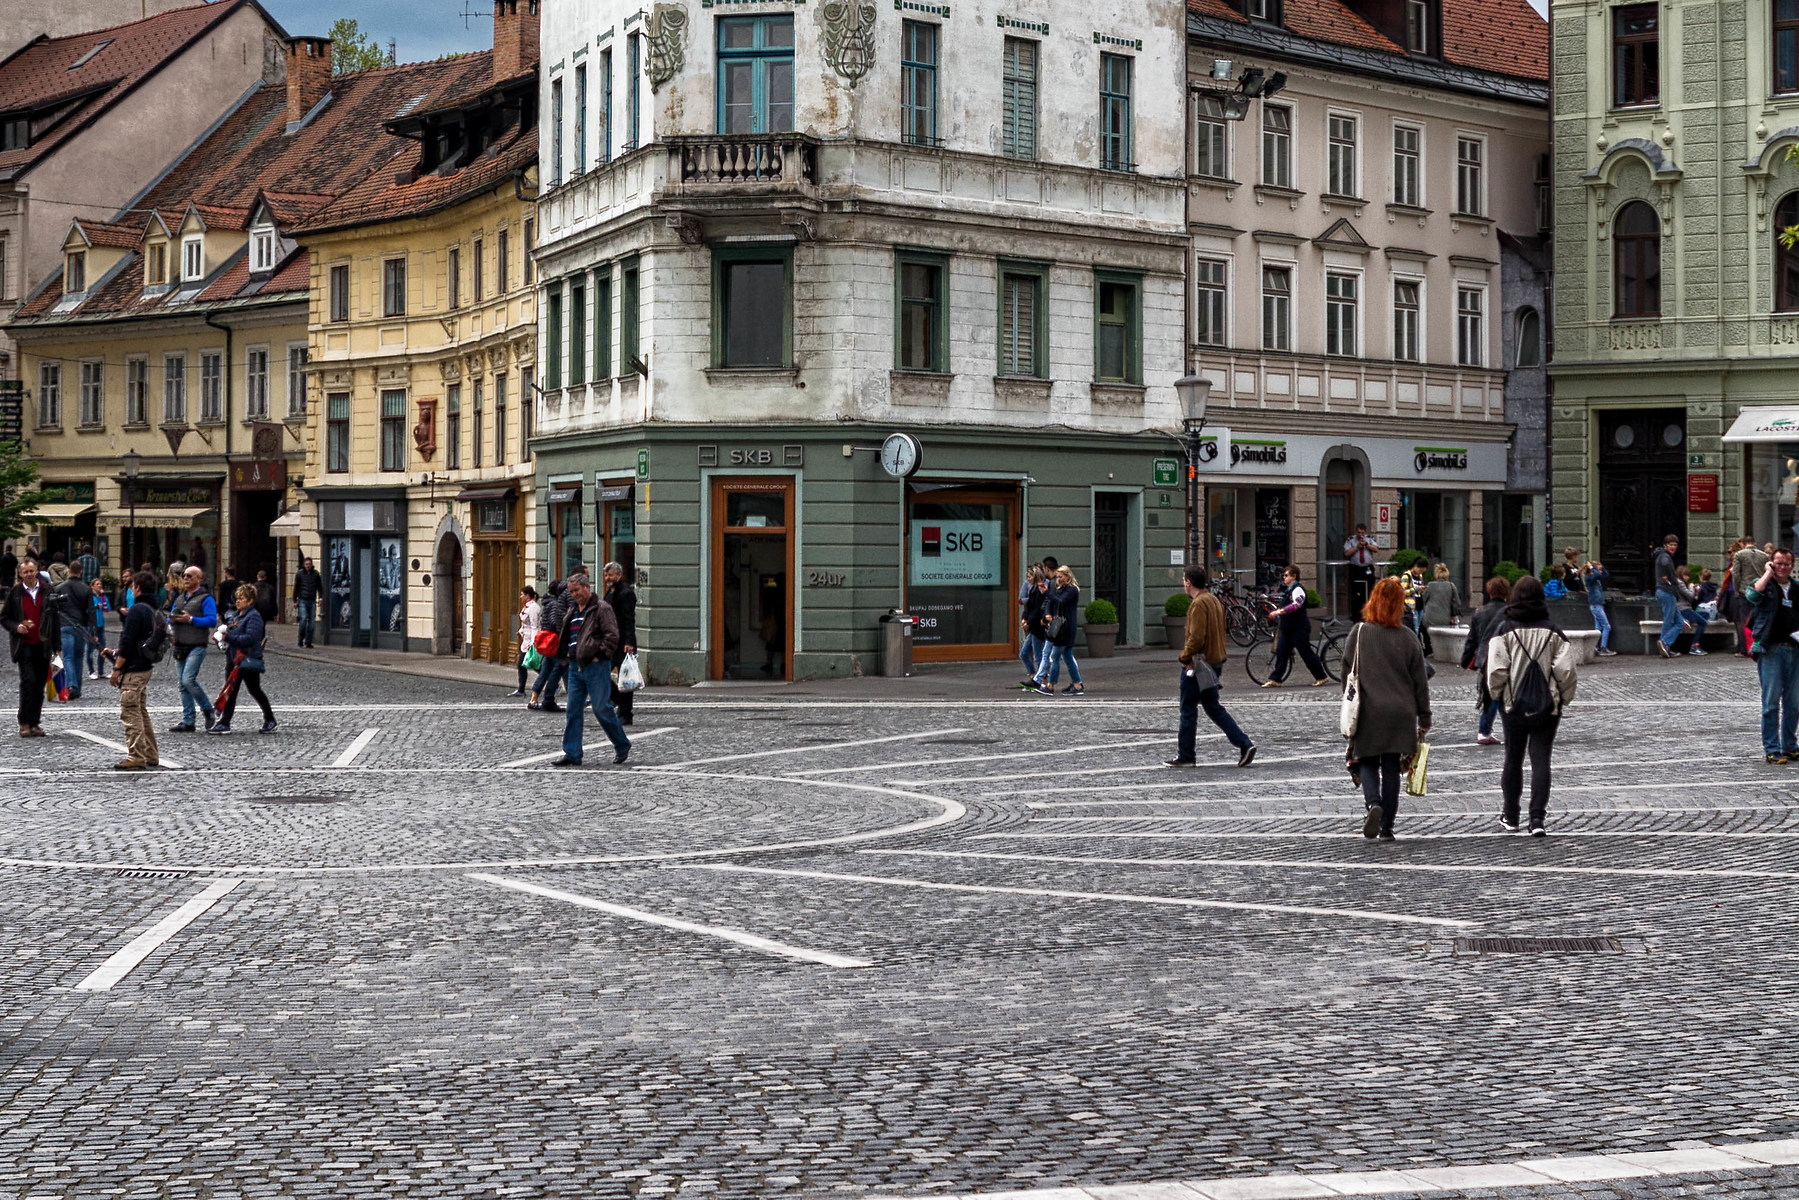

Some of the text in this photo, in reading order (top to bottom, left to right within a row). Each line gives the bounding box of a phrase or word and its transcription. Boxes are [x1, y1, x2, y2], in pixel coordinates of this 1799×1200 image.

[730, 449, 771, 464] SKB
[945, 532, 983, 552] SKB
[810, 570, 846, 586] 24ur
[919, 618, 938, 628] SKB
